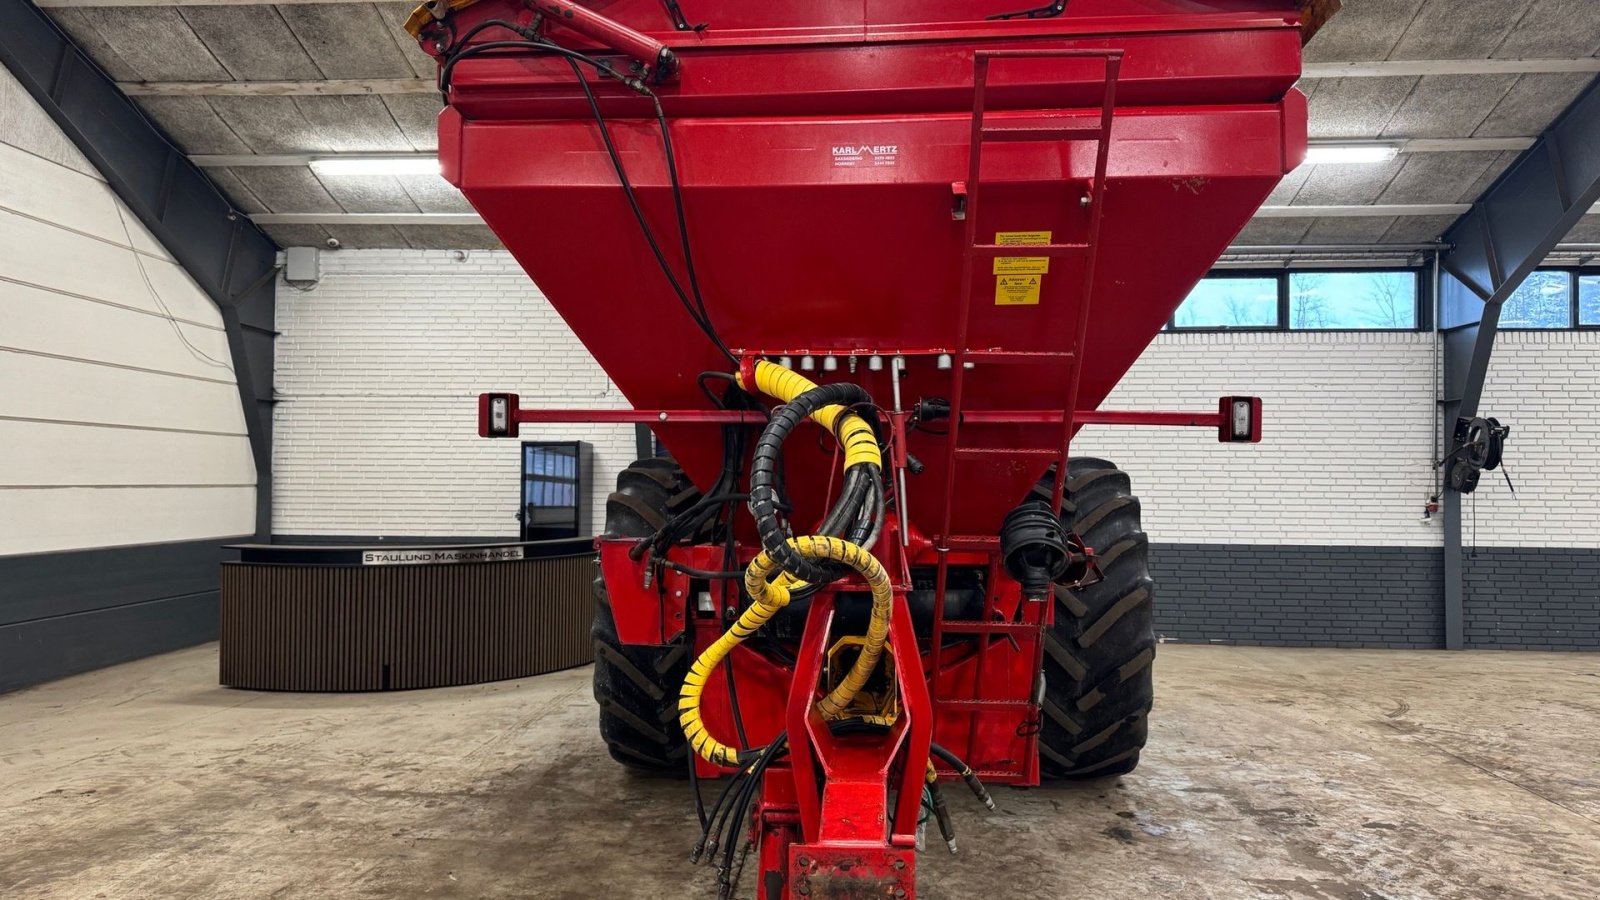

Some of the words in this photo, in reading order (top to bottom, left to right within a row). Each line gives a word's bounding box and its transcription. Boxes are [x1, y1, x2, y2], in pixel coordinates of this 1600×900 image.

[832, 146, 857, 155] KARL
[858, 145, 897, 155] MERTZ
[364, 553, 432, 562] STAULUND
[434, 550, 522, 561] MASKINHANDEL
